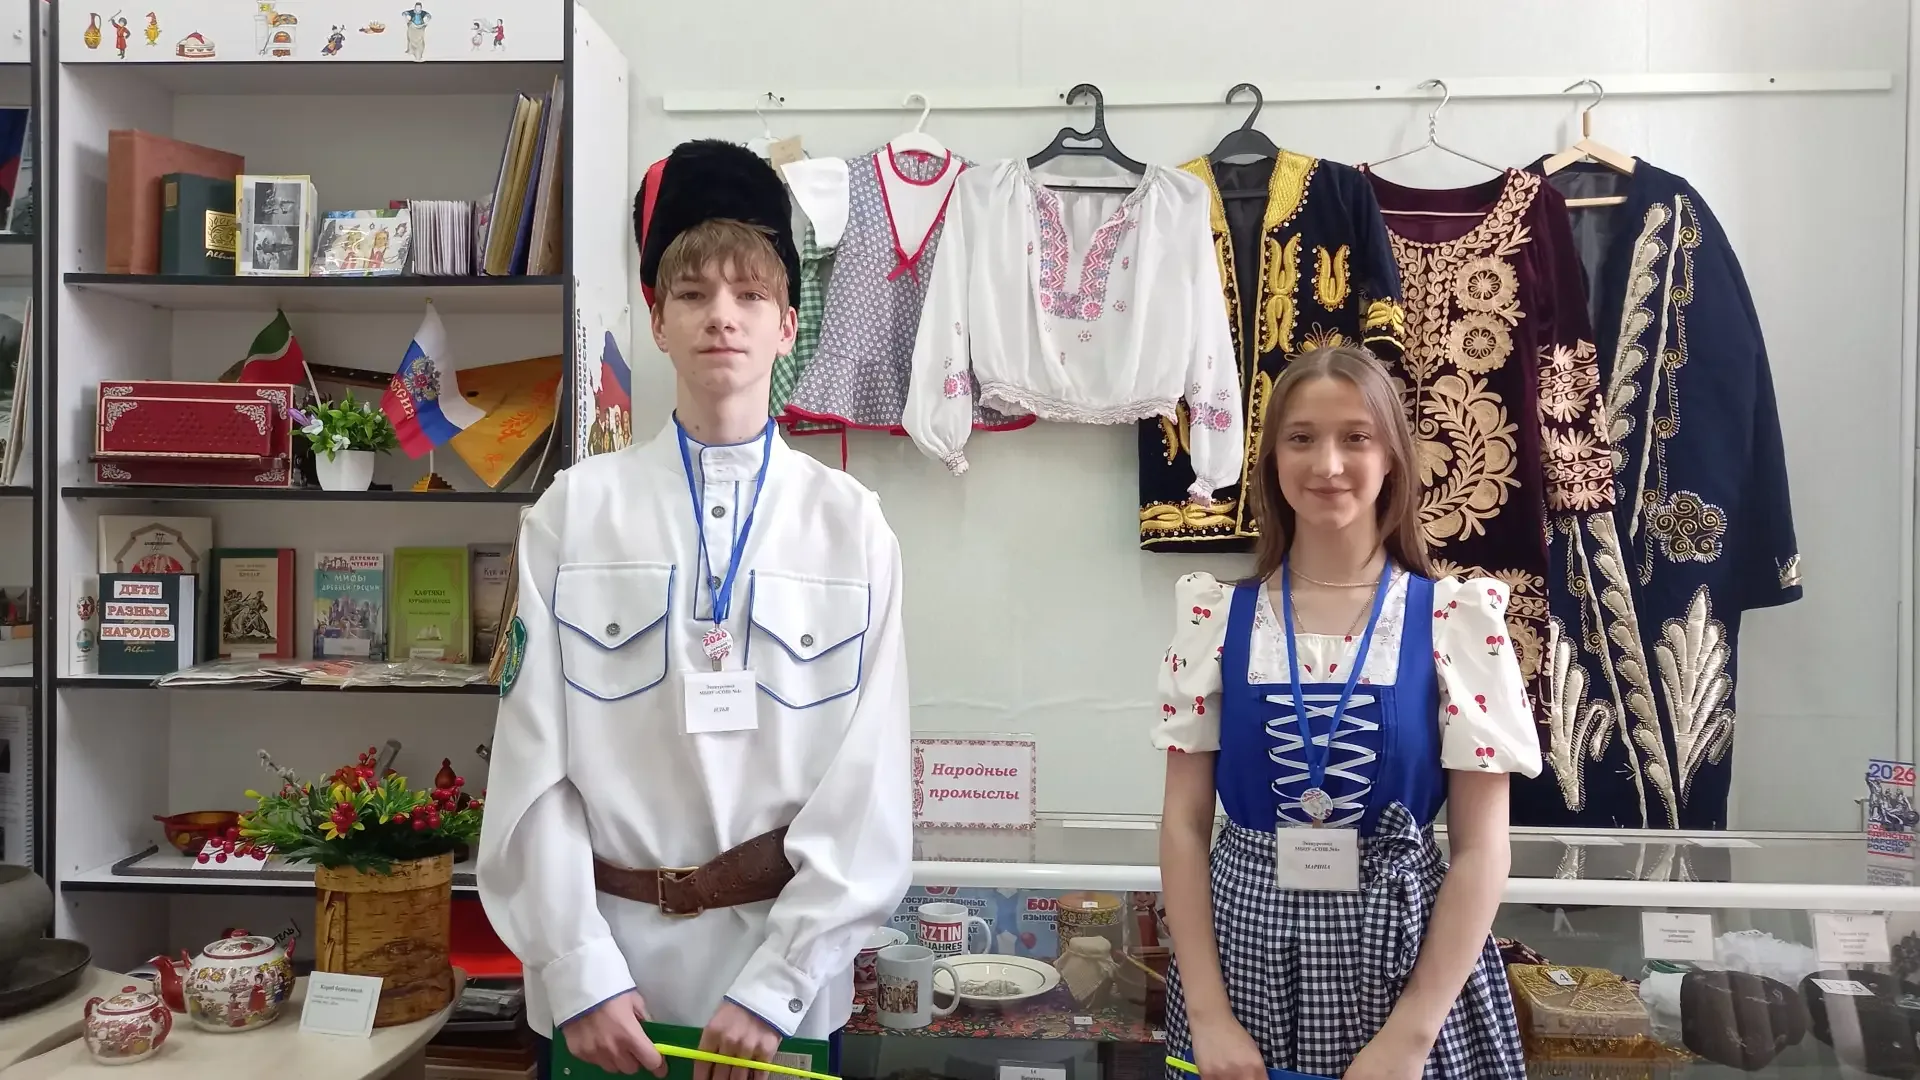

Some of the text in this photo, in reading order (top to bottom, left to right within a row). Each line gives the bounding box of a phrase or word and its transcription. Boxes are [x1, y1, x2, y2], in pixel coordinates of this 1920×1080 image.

[334, 574, 366, 582] МИФЫ
[119, 584, 160, 596] ДЕТИ
[107, 605, 168, 617] РАЗНЫХ
[102, 626, 171, 639] НАРОДОВ
[703, 631, 728, 647] 2026
[931, 762, 1018, 779] Народные
[1868, 763, 1916, 782] 2026
[929, 788, 1020, 802] промыслы
[1867, 830, 1914, 842] ЕДИНСТВА
[1867, 843, 1905, 853] РОССИИ
[1027, 898, 1059, 911] БОЛ
[920, 924, 961, 941] RZTIN
[1560, 973, 1569, 981] 4
